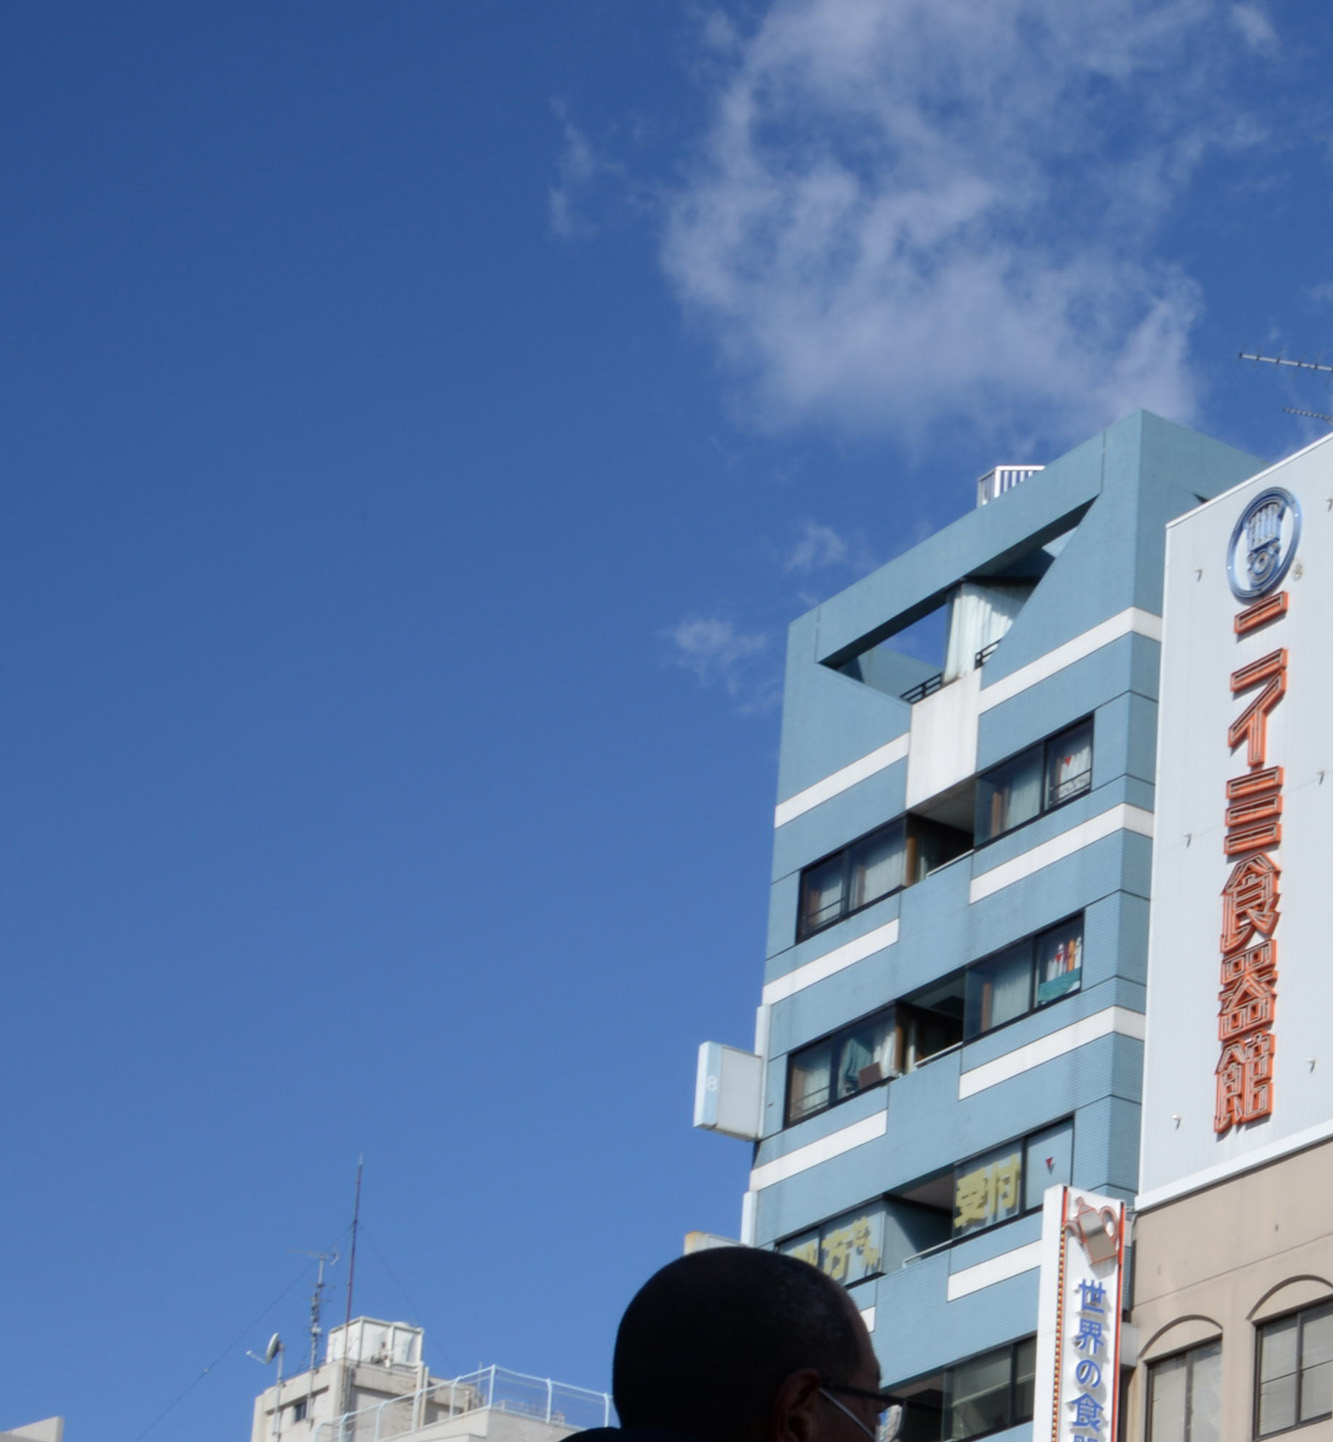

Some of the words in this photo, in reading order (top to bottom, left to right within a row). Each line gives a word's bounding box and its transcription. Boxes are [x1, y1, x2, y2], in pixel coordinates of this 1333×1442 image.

[1214, 591, 1288, 1136] ニイミ食器館
